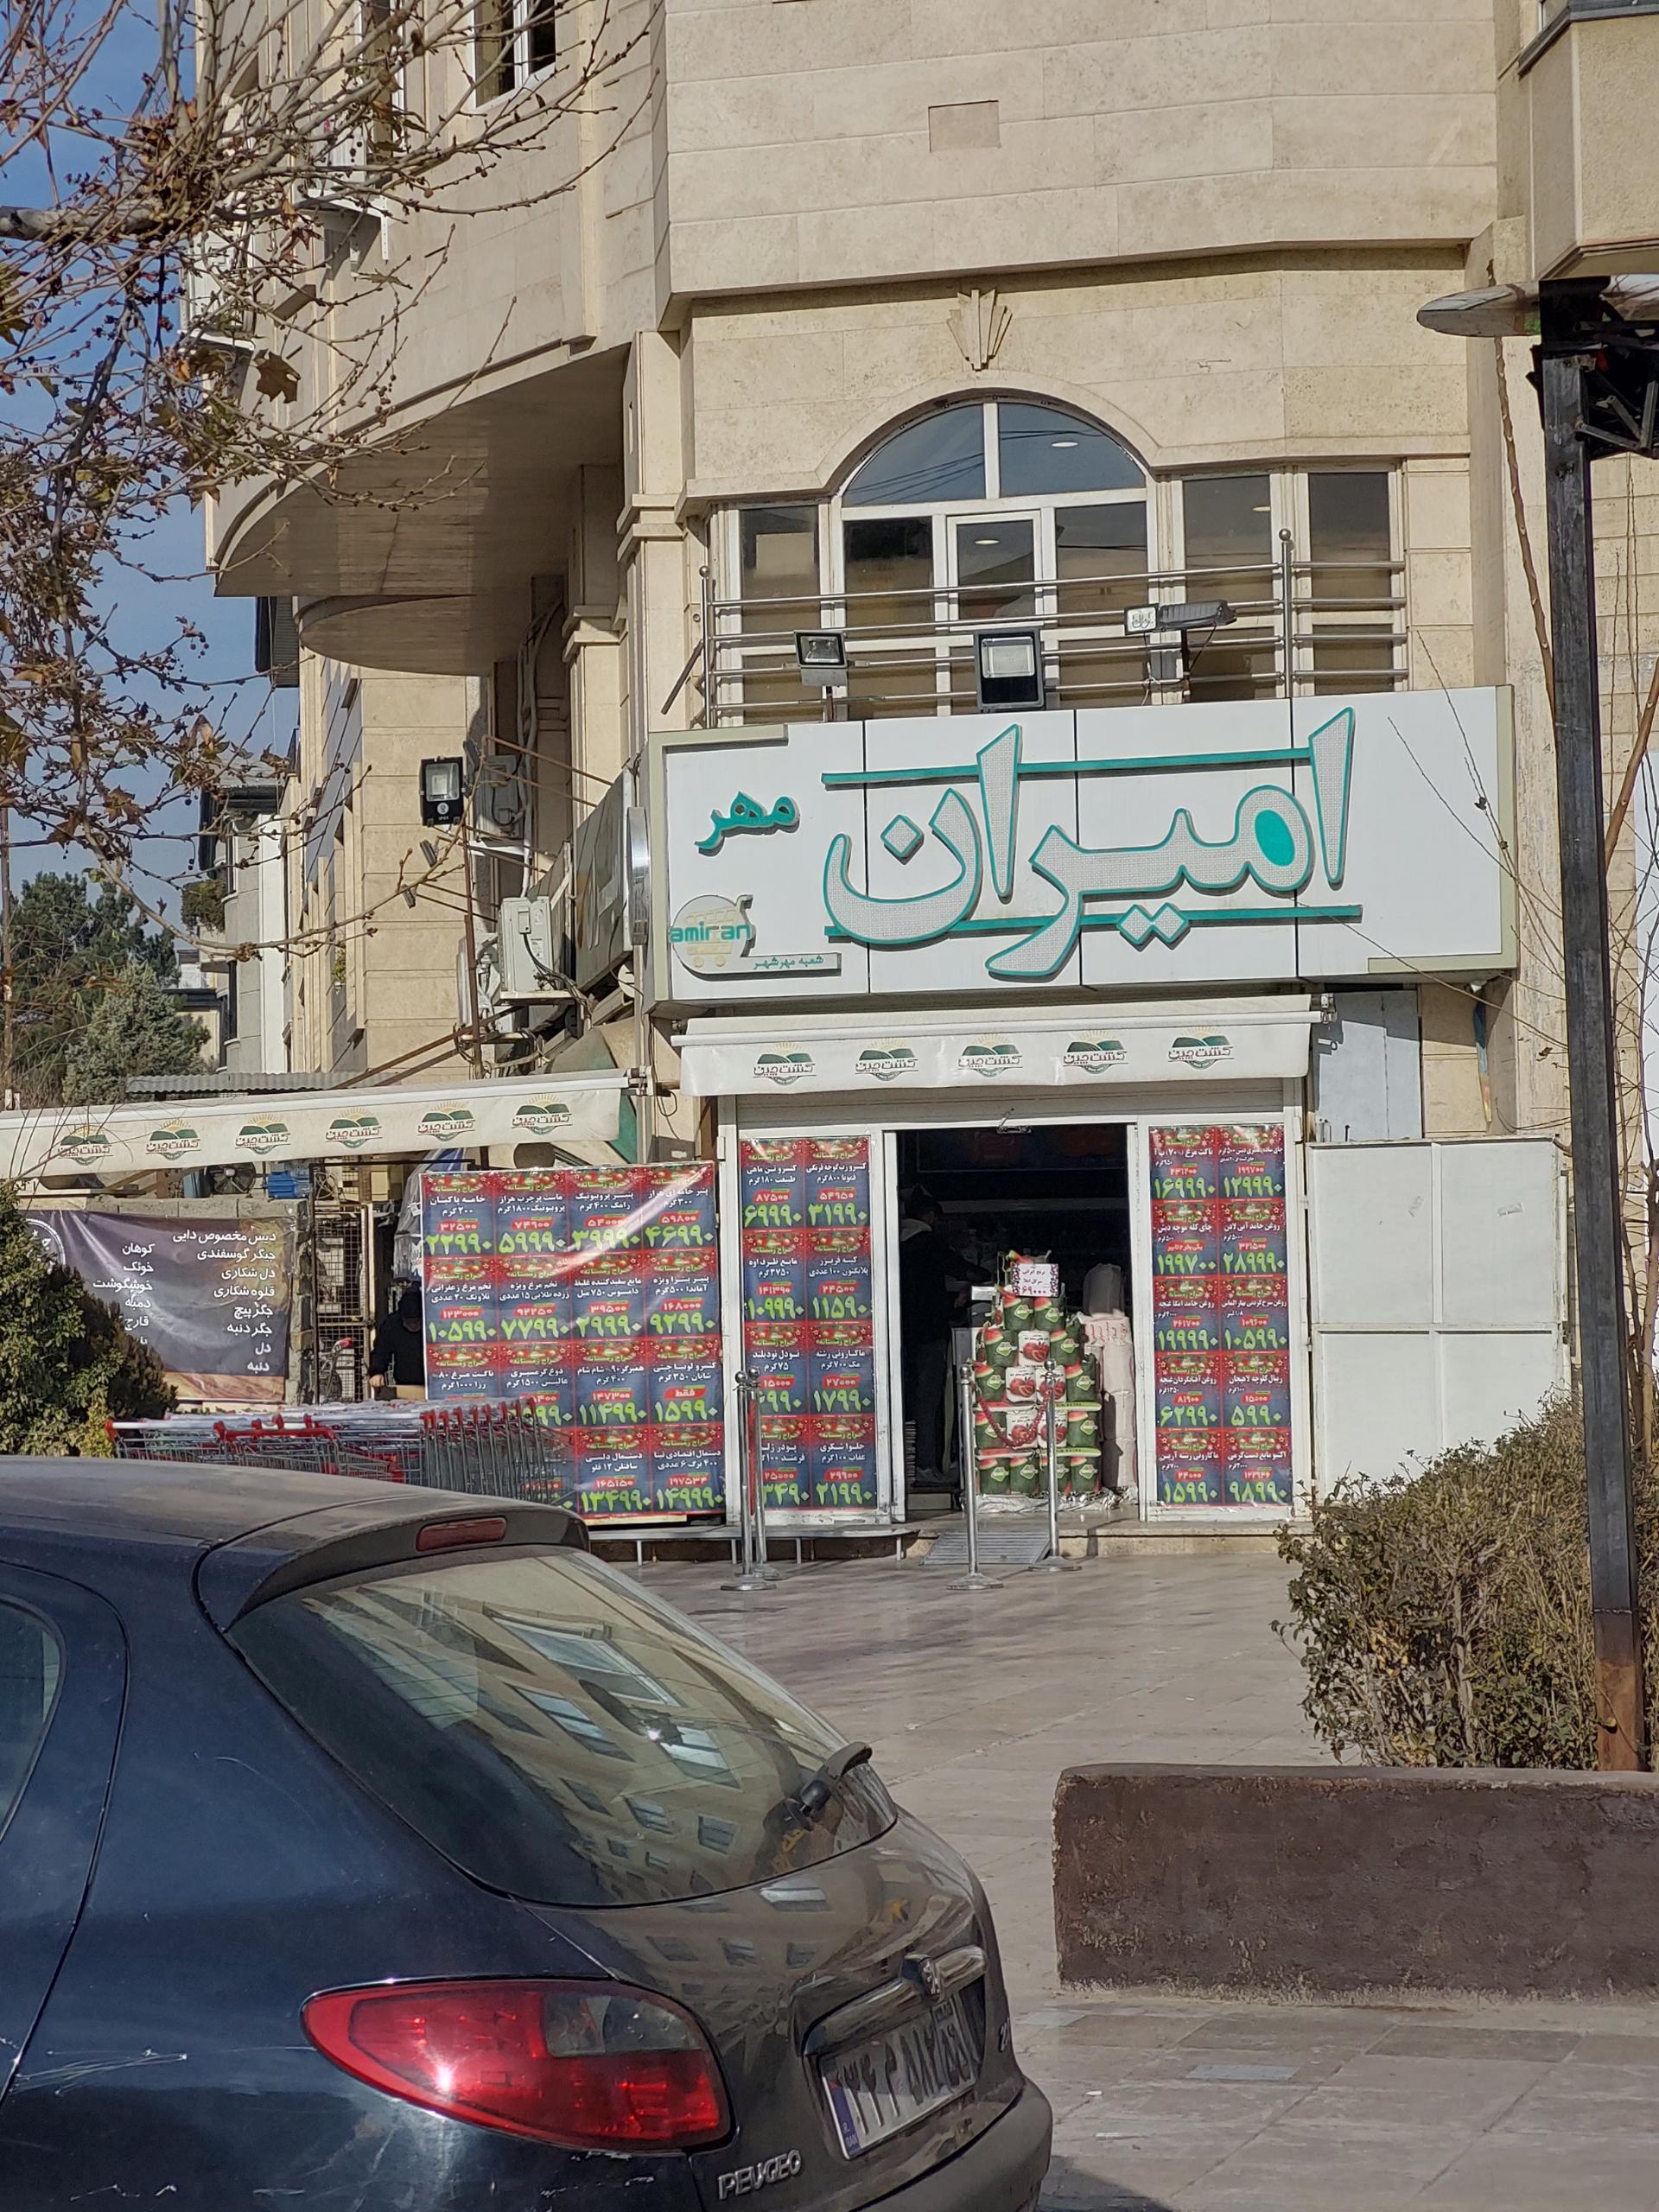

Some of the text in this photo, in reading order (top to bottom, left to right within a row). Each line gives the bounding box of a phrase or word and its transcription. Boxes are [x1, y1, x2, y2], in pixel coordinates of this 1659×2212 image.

[694, 791, 799, 850] مهر
[823, 706, 1354, 977] امیران
[669, 921, 751, 944] amiran
[753, 955, 823, 969] شعبه مهرشهر
[1185, 1149, 1196, 1158] مرغ
[1154, 1177, 1216, 1199] ۱۶۹۹۹۰
[745, 1205, 802, 1228] ۶۹۹۹۰
[808, 1203, 868, 1226] ۳۱۹۹۰
[173, 1230, 276, 1244] دیس مخصوص دایی
[426, 1233, 492, 1255] ۲۲۹۹۰
[499, 1231, 566, 1254] ۵۹۹۹۰
[572, 1228, 640, 1251] ۳۹۹۹۰
[645, 1224, 714, 1248] ۴۶۹۹۰
[122, 1243, 156, 1257] کوهان
[197, 1248, 276, 1262] جیگر گوسفندی
[749, 1259, 760, 1268] اوه
[820, 1256, 840, 1266] فریزر
[1158, 1253, 1216, 1274] ۱۹۹۷۰۰
[1224, 1251, 1285, 1274] ۲۸۹۹۹۰
[221, 1267, 275, 1280] دل شکاری
[809, 1268, 828, 1277] عددی
[214, 1285, 275, 1300] قلوه شکاری
[431, 1284, 460, 1293] زعفرانی
[462, 1284, 475, 1293] مرغ
[528, 1281, 542, 1290] مرغ
[531, 1291, 552, 1300] طلایی
[553, 1291, 570, 1300] زرده
[499, 1293, 519, 1301] عددی
[812, 1296, 868, 1319] ۱۱۵۹۰
[747, 1297, 804, 1320] ۱۰۹۹۹۰
[124, 1316, 149, 1331] قارچ
[227, 1322, 272, 1337] جگر دنبه
[429, 1319, 497, 1343] ۱۰۵۹۹۰
[501, 1317, 569, 1339] ۷۷۹۹۰
[575, 1315, 642, 1337] ۲۹۹۹۰
[650, 1312, 715, 1335] ۹۲۹۹۰
[256, 1342, 271, 1355] دل
[1158, 1329, 1218, 1351] ۱۹۹۹۹۰
[1224, 1328, 1287, 1350] ۱۰۵۹۹۰
[779, 1350, 800, 1360] نودل
[816, 1350, 865, 1359] ماکارونی رشته
[247, 1362, 270, 1374] دنبه
[451, 1370, 470, 1379] مرغ
[696, 1363, 716, 1371] کنسرو
[1230, 1376, 1249, 1384] لاهیجان
[675, 1389, 695, 1397] فقط
[813, 1389, 871, 1413] ۱۷۹۹۰
[579, 1402, 647, 1425] ۱۱۴۹۹۰
[654, 1400, 718, 1422] ۱۵۹۹۰
[1160, 1405, 1217, 1427] ۶۲۹۹۰
[1231, 1405, 1282, 1426] ۵۹۹۰
[778, 1443, 797, 1452] پودر
[820, 1444, 844, 1452] شکری
[670, 1477, 708, 1485] ۱۹۷۵۳۴
[582, 1490, 651, 1512] ۱۳۴۹۹۰
[657, 1487, 723, 1510] ۱۴۹۹۹۰
[816, 1482, 872, 1505] ۲۱۹۹۰
[1164, 1482, 1217, 1503] ۱۵۹۹۰
[1230, 1481, 1287, 1503] ۹۸۹۹۰
[718, 2150, 801, 2200] PEUGEO
